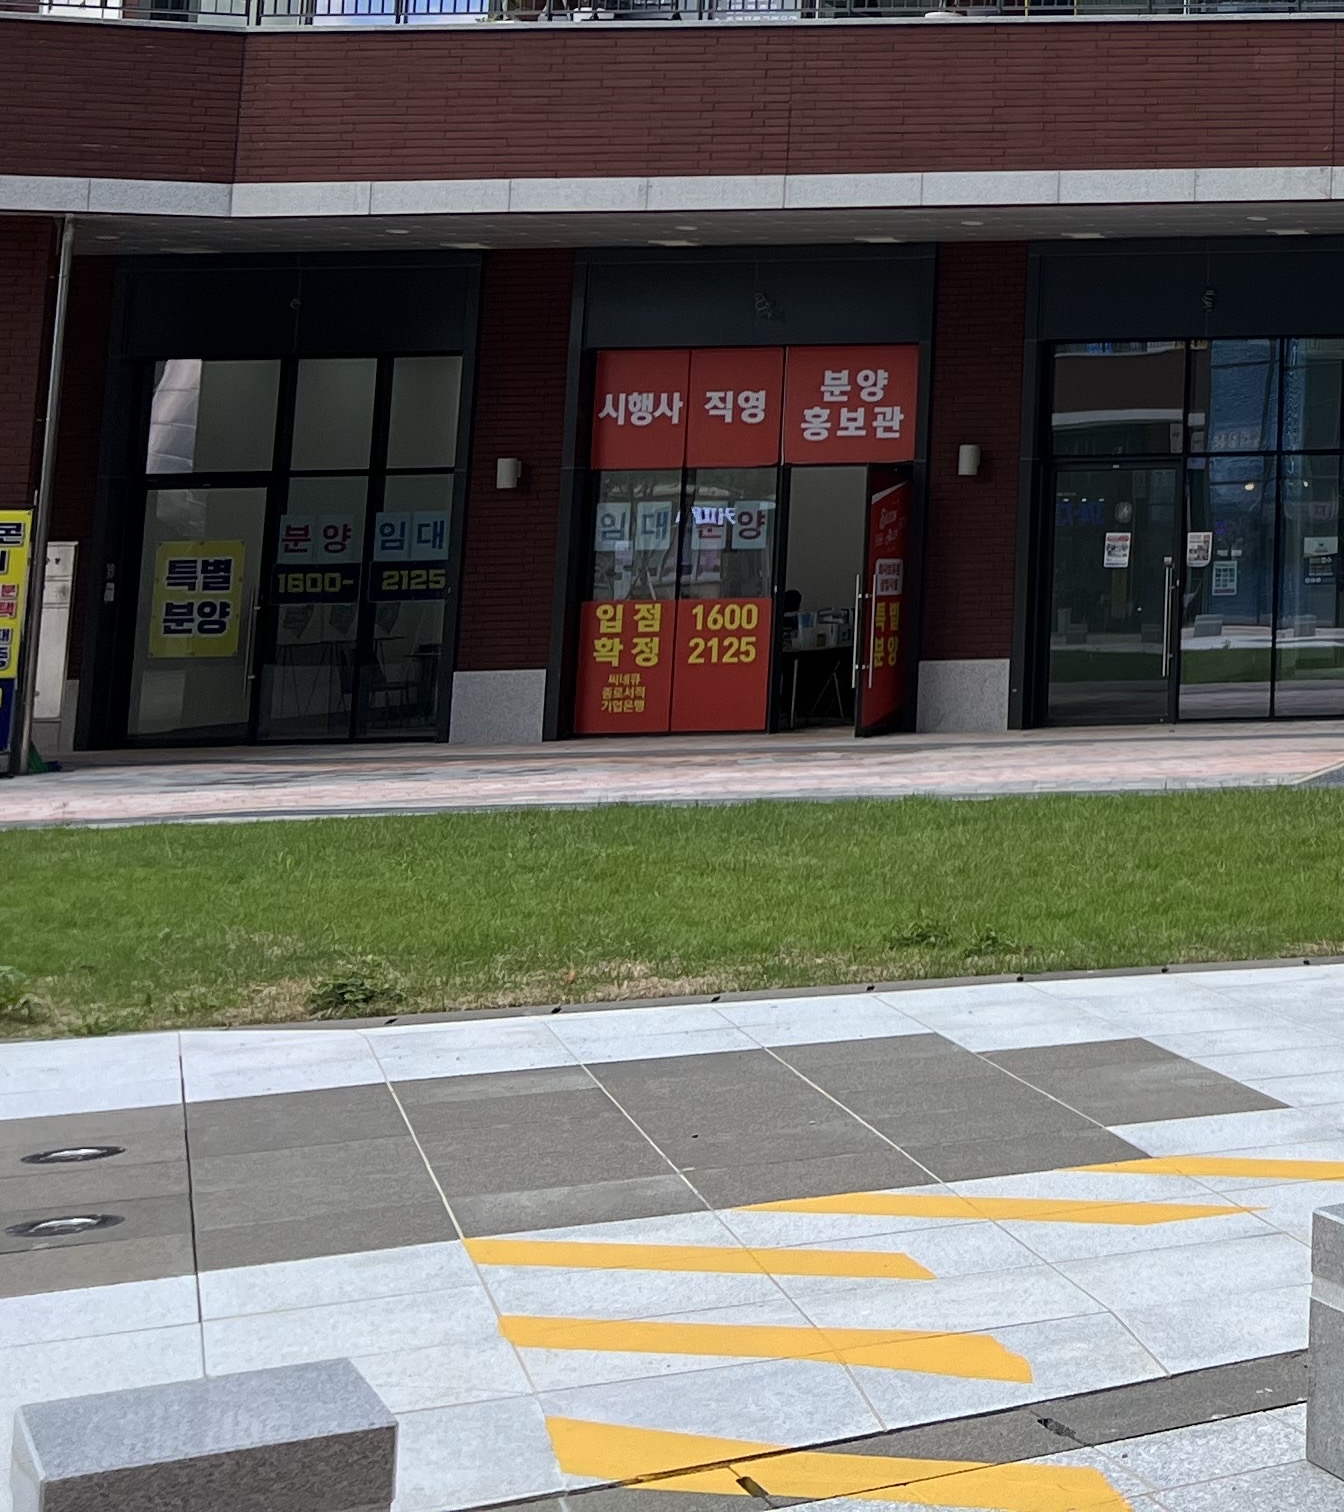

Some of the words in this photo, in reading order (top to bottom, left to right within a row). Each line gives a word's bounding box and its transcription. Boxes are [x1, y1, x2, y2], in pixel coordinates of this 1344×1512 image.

[820, 369, 889, 403] 분양
[598, 392, 685, 427] 시행사
[704, 390, 767, 424] 직영
[800, 406, 905, 442] 홍보관
[165, 557, 233, 593] 특별
[161, 599, 232, 636] 분양
[691, 602, 759, 631] 1600
[592, 636, 660, 668] 확정
[687, 635, 757, 665] 2125
